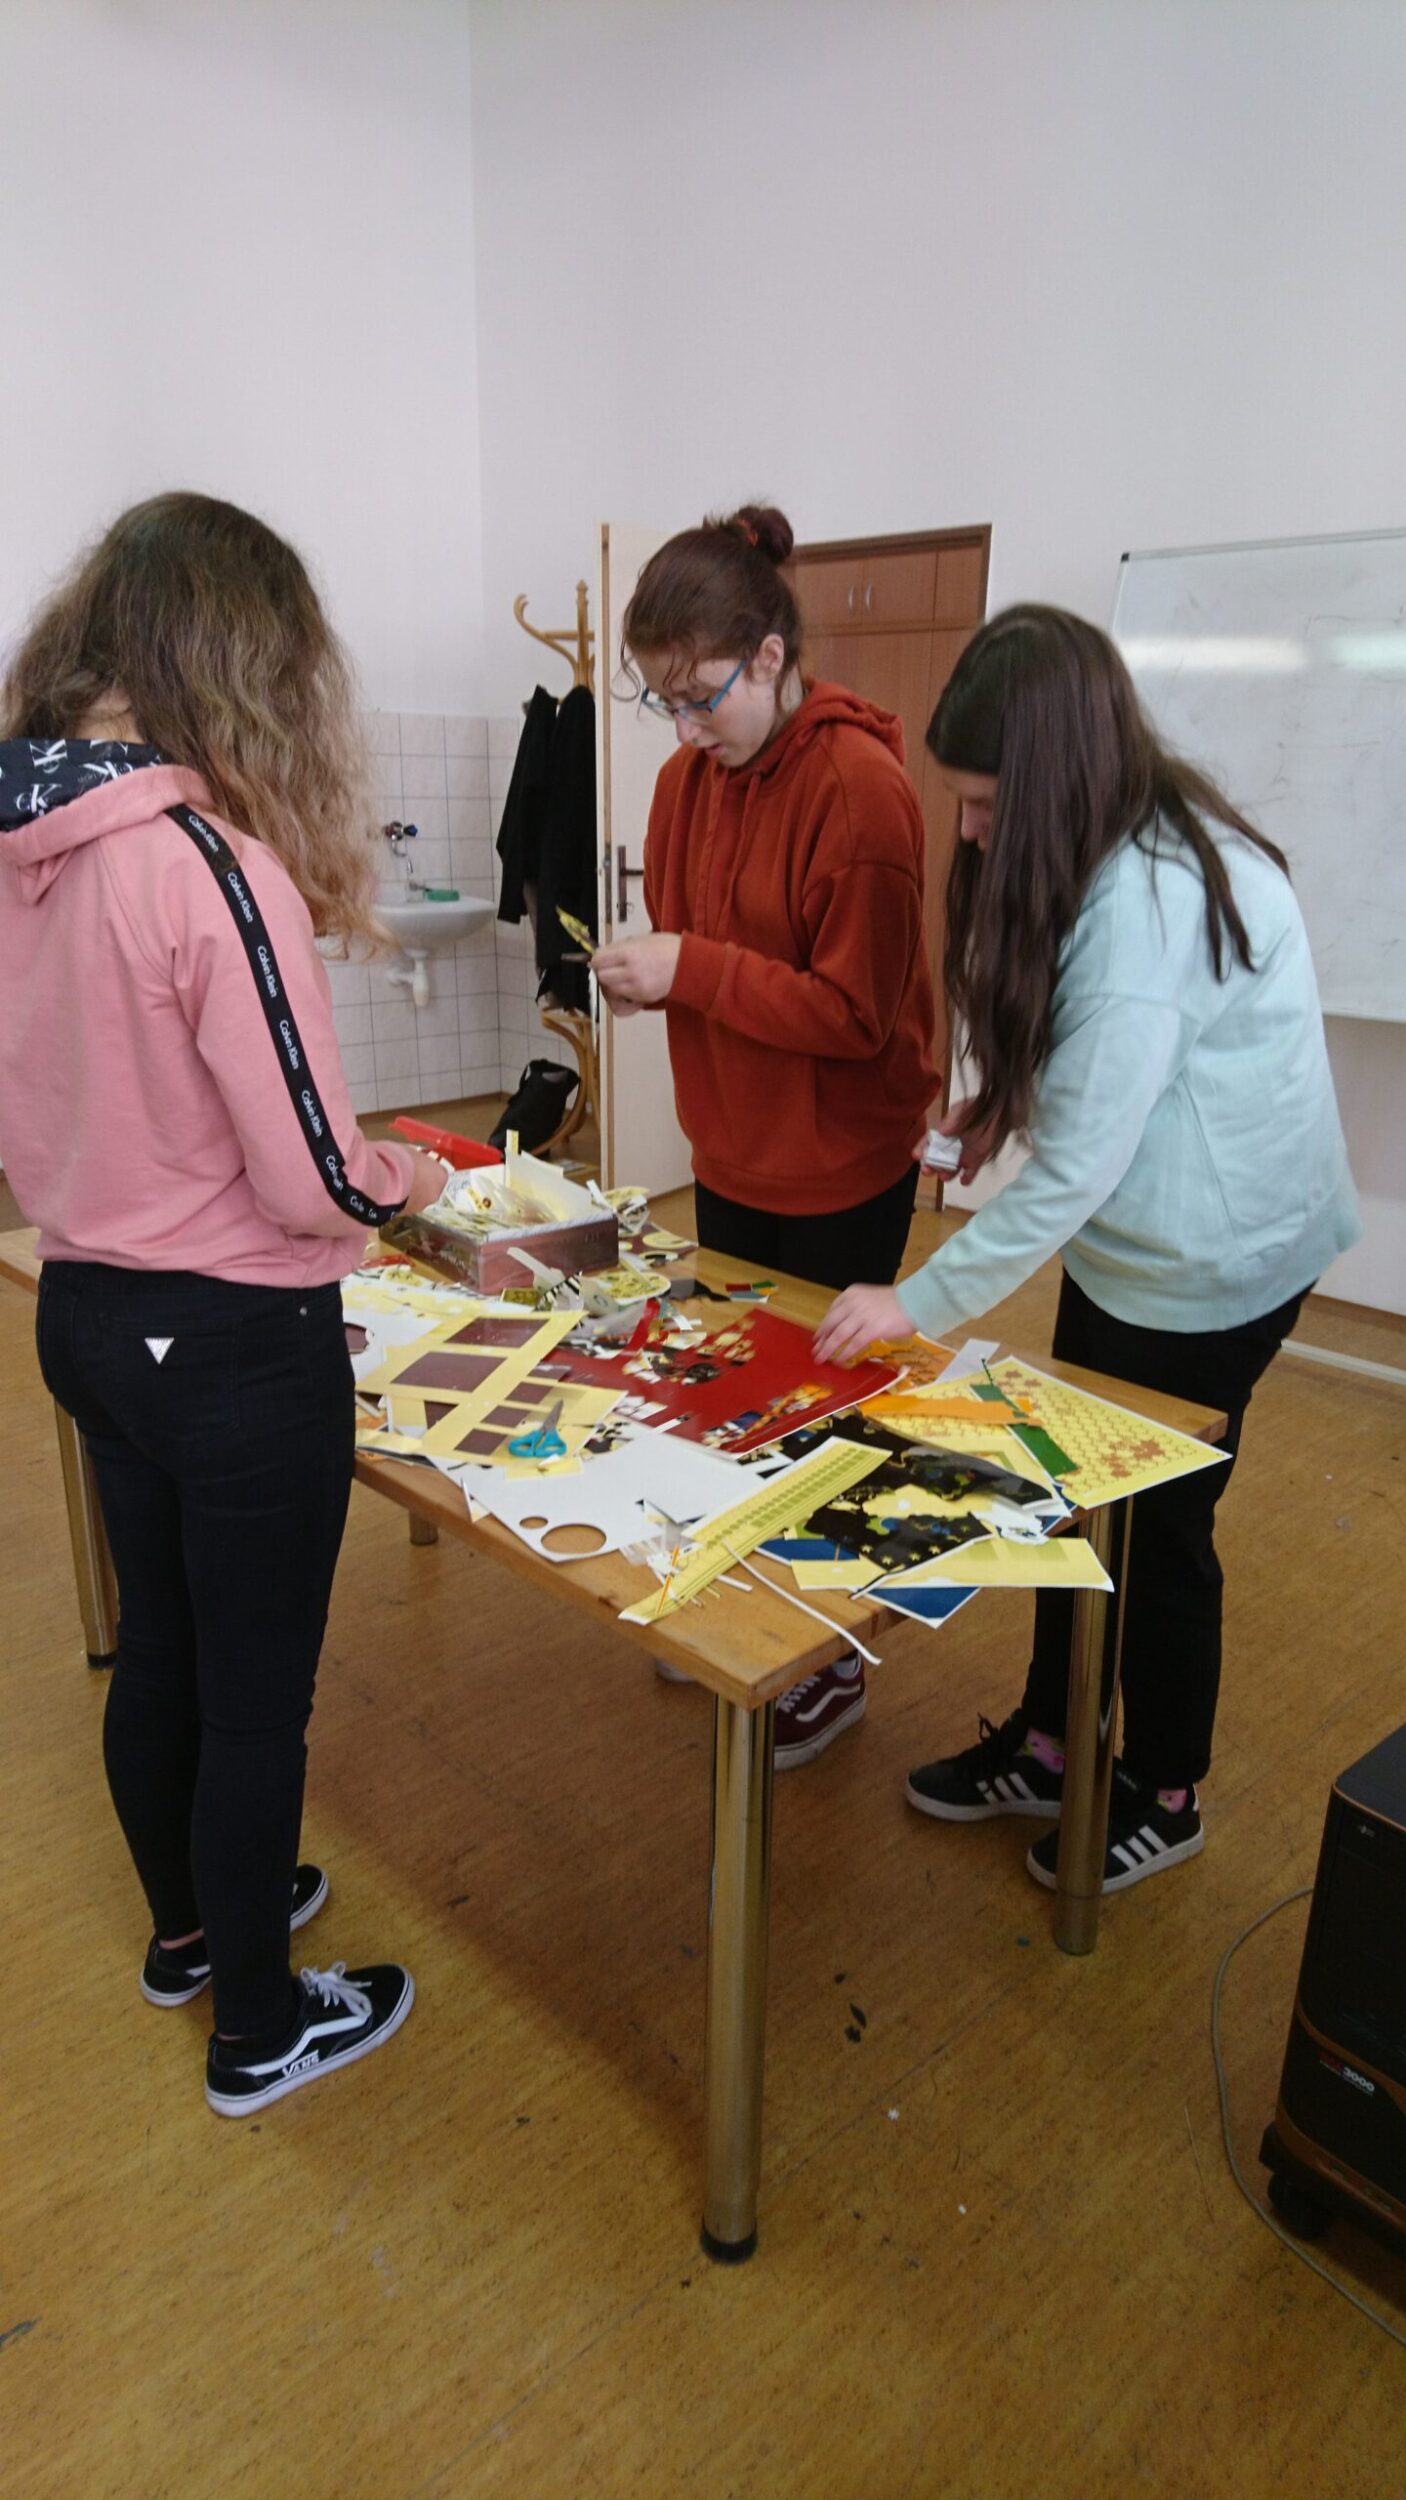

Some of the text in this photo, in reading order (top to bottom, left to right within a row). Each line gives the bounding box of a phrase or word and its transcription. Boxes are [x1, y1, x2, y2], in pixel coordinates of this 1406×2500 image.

[228, 872, 254, 924] Calvin Klein
[257, 945, 279, 998] Calvin Klein
[280, 1020, 299, 1070] Calvin Klein
[302, 1090, 323, 1137] Calvin Klein
[282, 2050, 320, 2077] VANS
[1343, 2066, 1375, 2092] 3000
